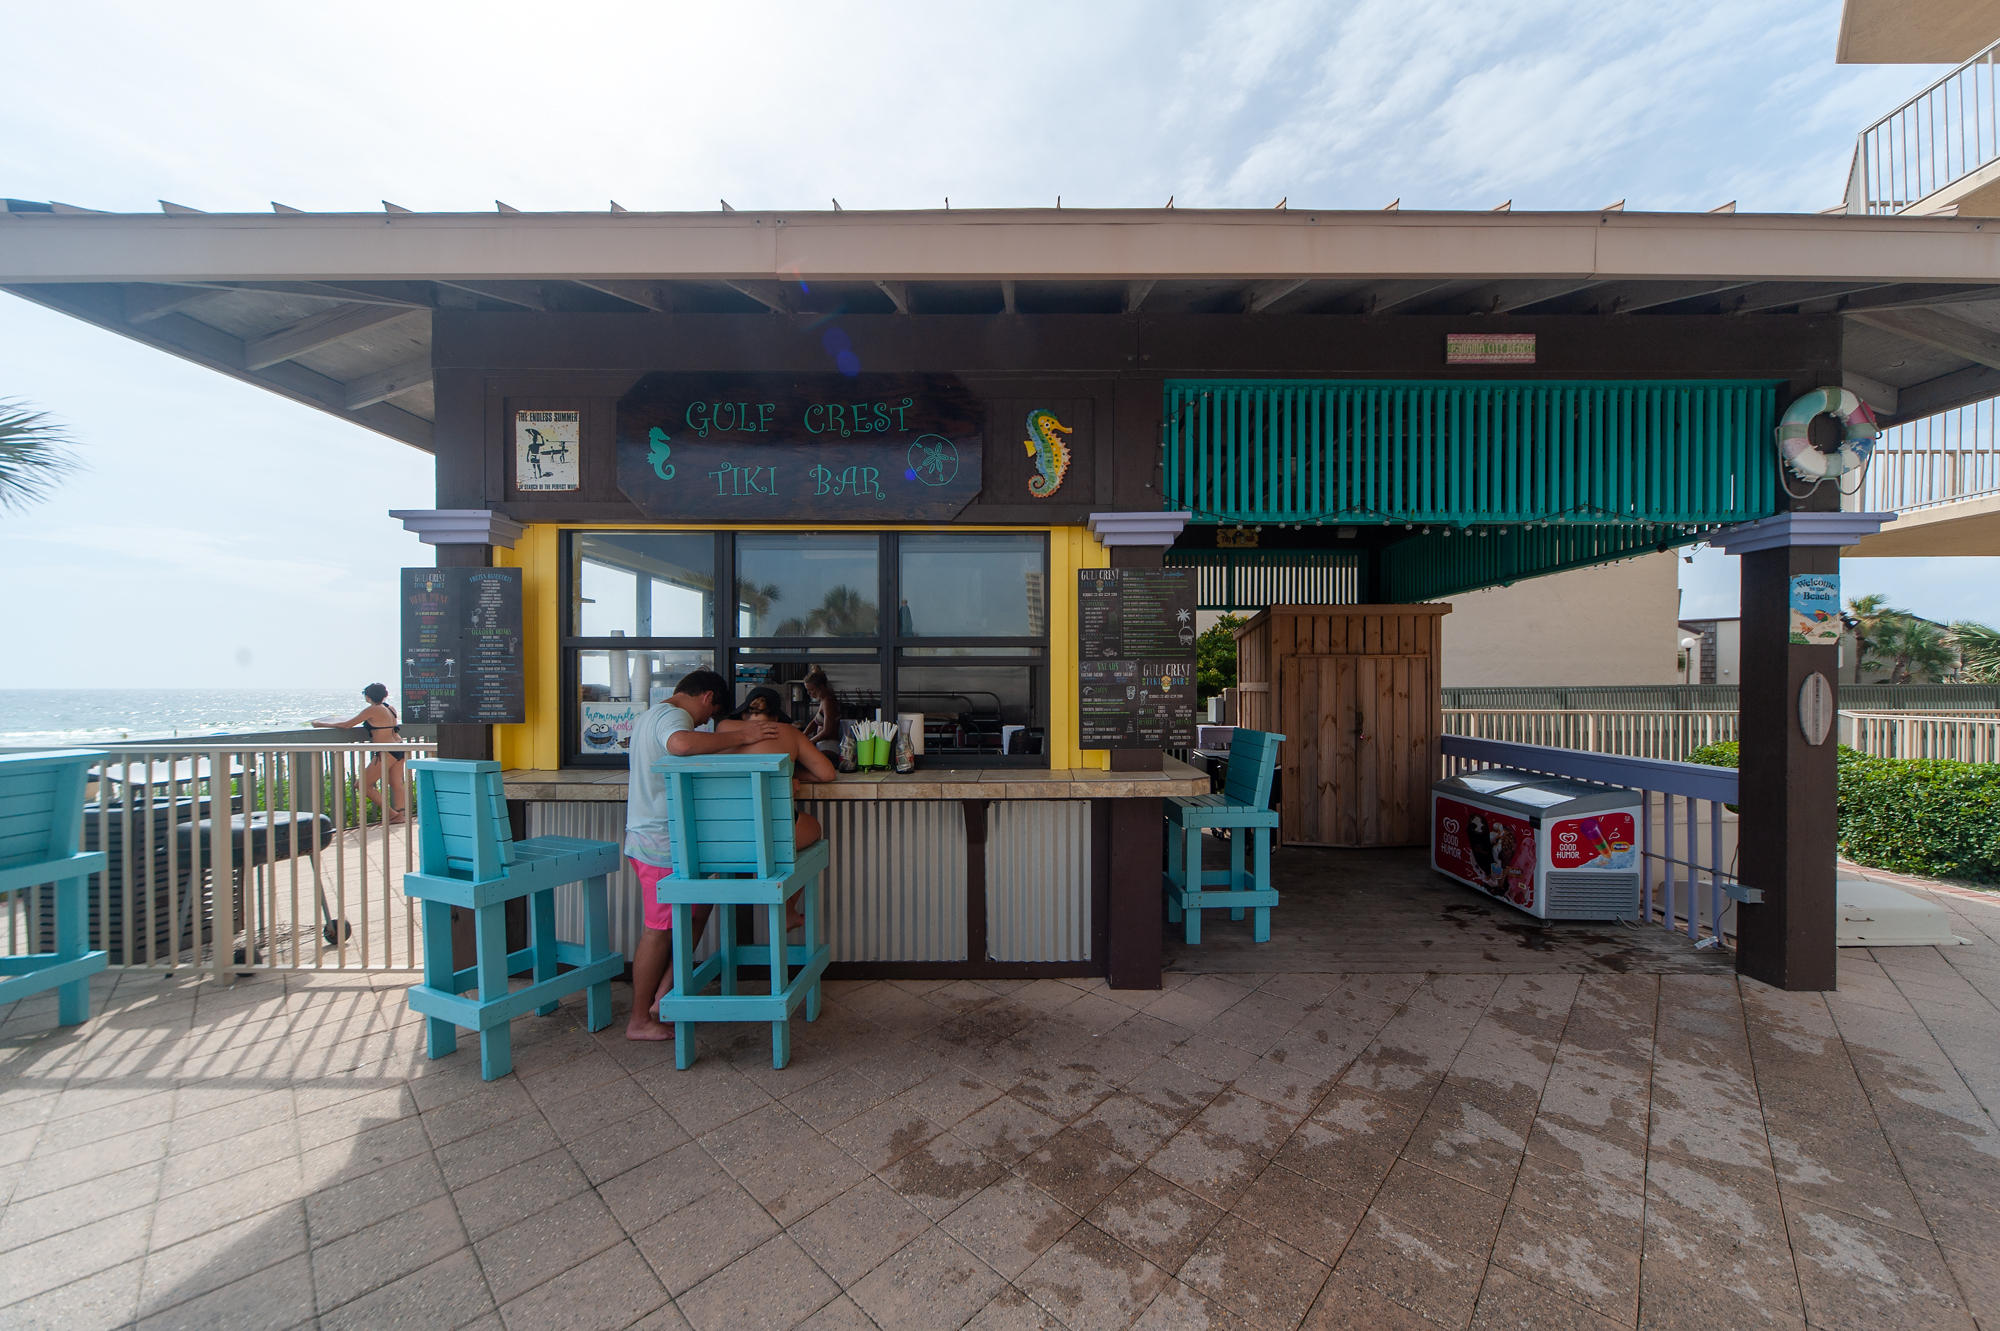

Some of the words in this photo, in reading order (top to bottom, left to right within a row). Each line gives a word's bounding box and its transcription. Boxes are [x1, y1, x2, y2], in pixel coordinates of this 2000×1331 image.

[518, 412, 528, 422] THE
[529, 412, 553, 422] ENDLESS
[554, 412, 578, 422] SUMMER
[685, 401, 776, 438] GULF
[803, 398, 913, 437] CREST
[708, 461, 780, 496] TIKI
[809, 463, 886, 501] BAR
[1796, 578, 1837, 590] Welcome
[1803, 591, 1830, 600] Beach
[585, 706, 636, 723] homemade
[1443, 833, 1459, 847] GOOD
[1441, 843, 1462, 860] HUMOR
[1559, 843, 1577, 851] GOOD
[1556, 851, 1580, 859] HUMOR
